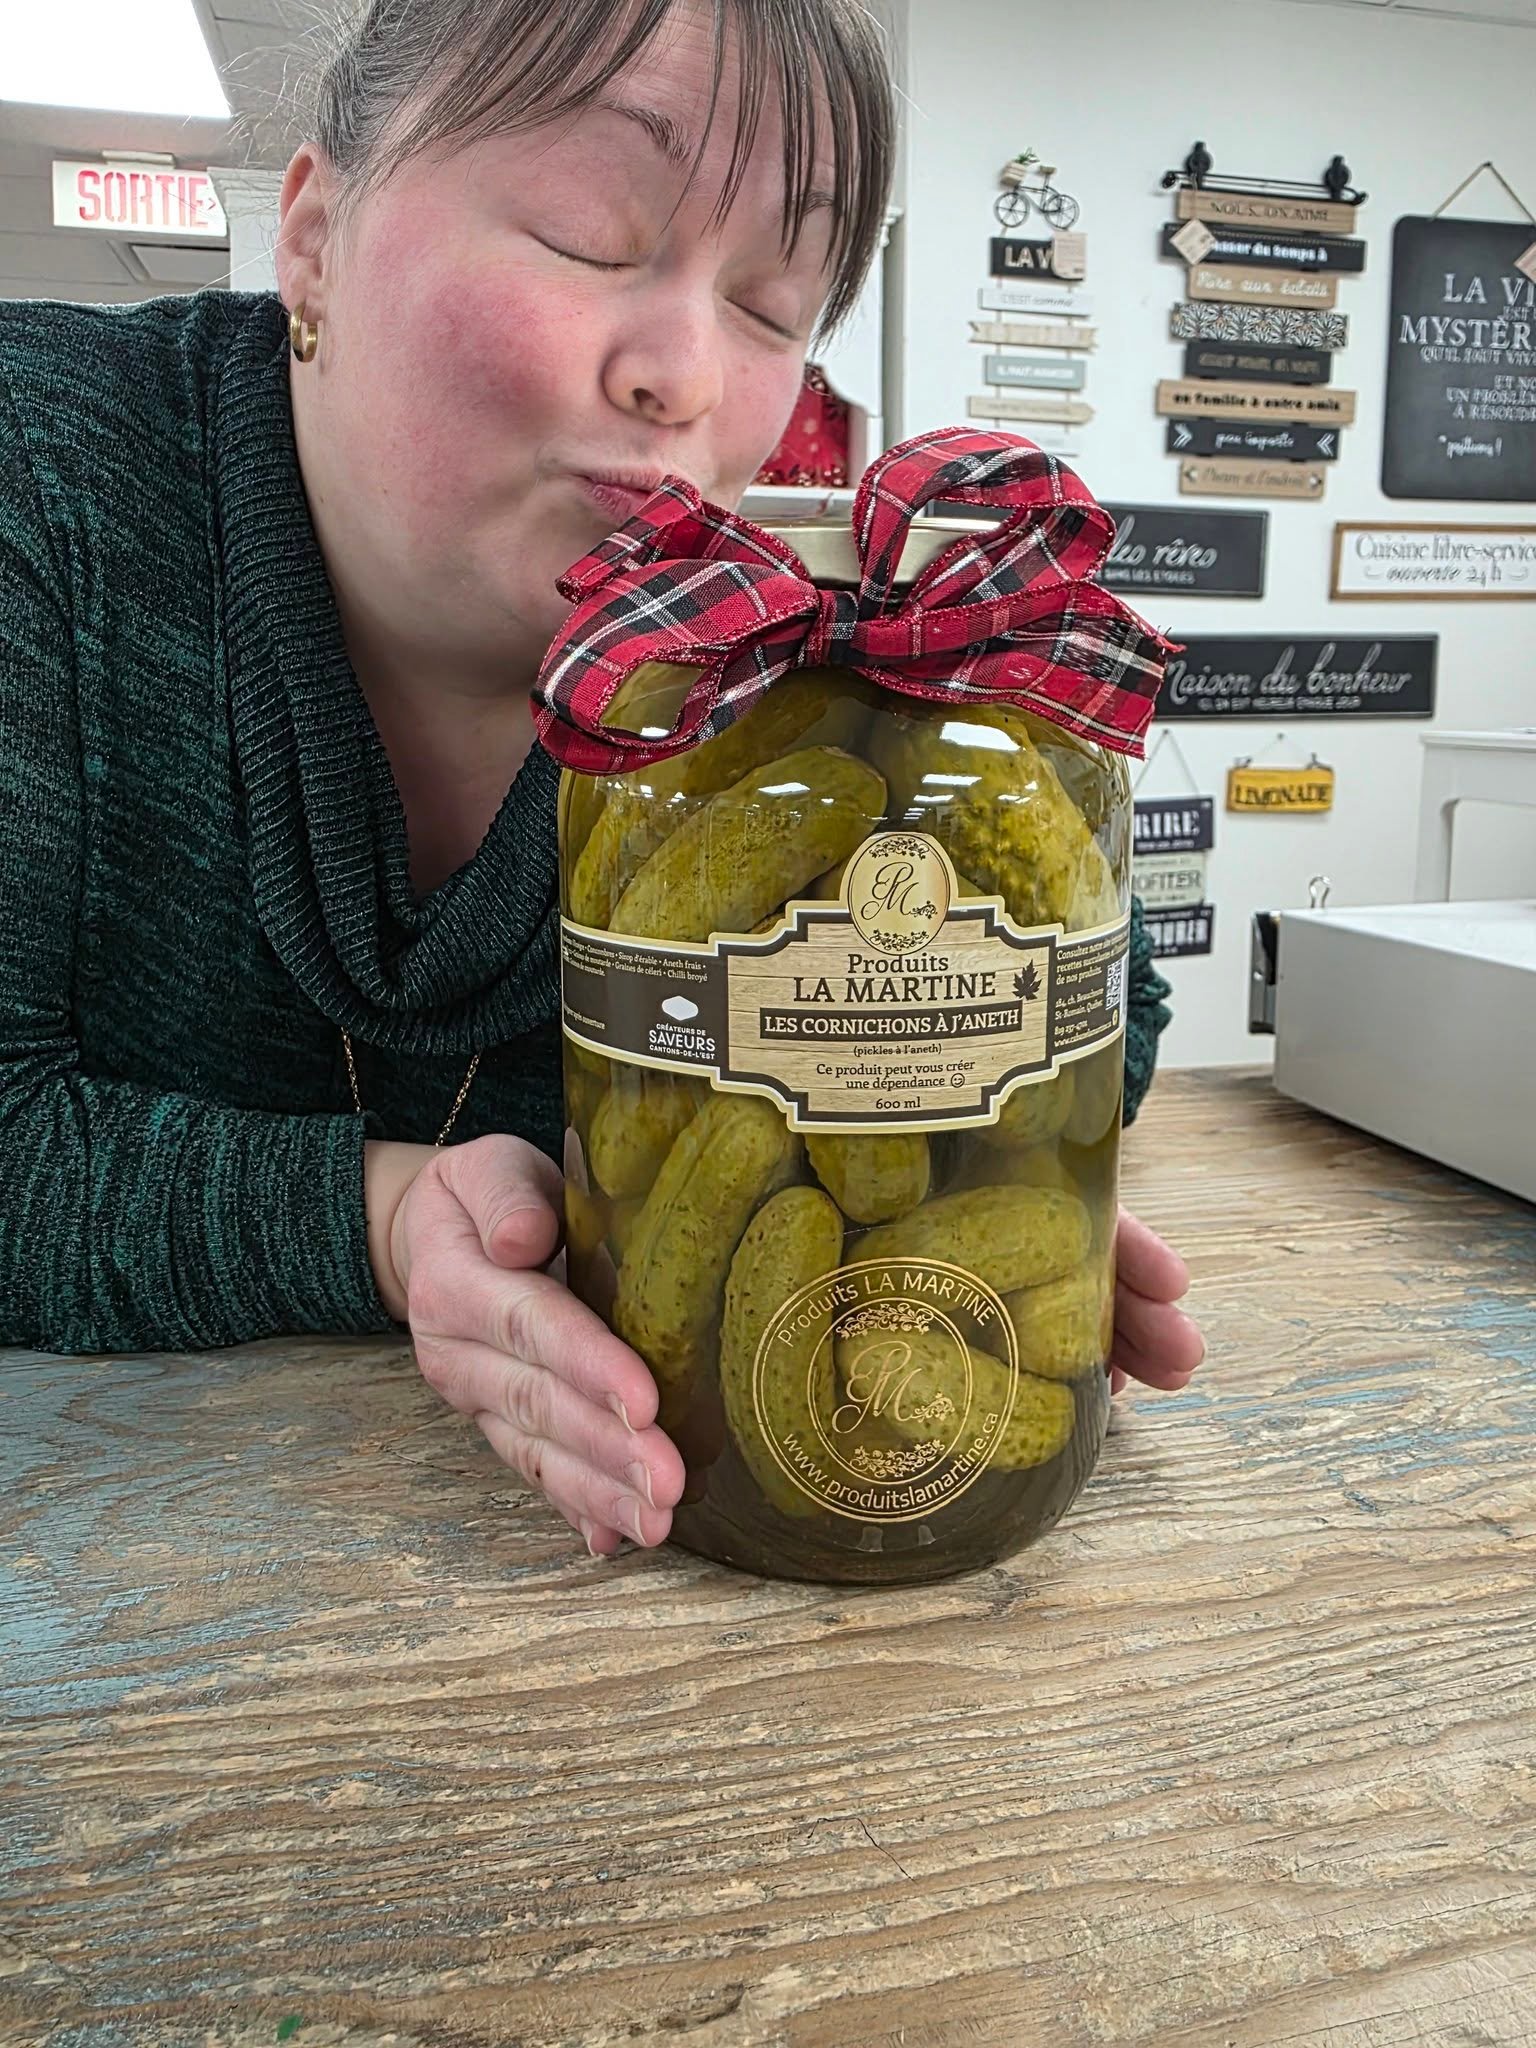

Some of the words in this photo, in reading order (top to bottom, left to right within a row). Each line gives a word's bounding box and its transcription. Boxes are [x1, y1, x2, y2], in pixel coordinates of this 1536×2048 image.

[77, 169, 209, 228] SORTIE
[1004, 244, 1035, 269] LA
[1211, 240, 1251, 256] asser
[1441, 273, 1488, 304] LA
[1500, 276, 1536, 307] VI
[1398, 314, 1536, 351] MYSTÈR
[1152, 537, 1218, 569] rêves
[1356, 533, 1429, 561] Cuisine
[1432, 534, 1536, 563] libre-servic
[1260, 645, 1300, 694] du
[1305, 642, 1412, 694] bonheur
[1133, 869, 1201, 892] OFITER
[615, 961, 636, 973] Graines
[687, 971, 708, 983] broyé
[662, 958, 684, 969] Aneth
[685, 961, 702, 970] frais
[848, 952, 949, 974] Produits
[793, 976, 836, 1003] LA
[844, 972, 996, 1004] MARTINE
[1056, 974, 1066, 985] de
[656, 1022, 695, 1035] CRÉATEURS
[765, 1016, 798, 1033] LES
[801, 1017, 931, 1036] CORNICHONS
[934, 1012, 949, 1032] À
[950, 1008, 1019, 1034] J'ANETH
[649, 1029, 716, 1052] SAVEURS
[649, 1044, 715, 1060] CANTONS-DE-L'EST
[853, 1045, 893, 1057] (pickles
[895, 1046, 902, 1055] à
[903, 1043, 942, 1055] l'aneth)
[816, 1063, 833, 1075] Ce
[835, 1063, 882, 1081] produit
[885, 1065, 912, 1078] peut
[915, 1064, 943, 1074] vous
[946, 1060, 976, 1072] créer
[846, 1078, 870, 1090] une
[872, 1075, 945, 1092] dépendance
[875, 1098, 901, 1110] 600
[903, 1096, 921, 1108] ml
[777, 1282, 859, 1347] Produits
[864, 1272, 896, 1296] LA
[902, 1271, 996, 1327] MARTINE
[782, 1411, 999, 1510] www.produitslamartine.ca
